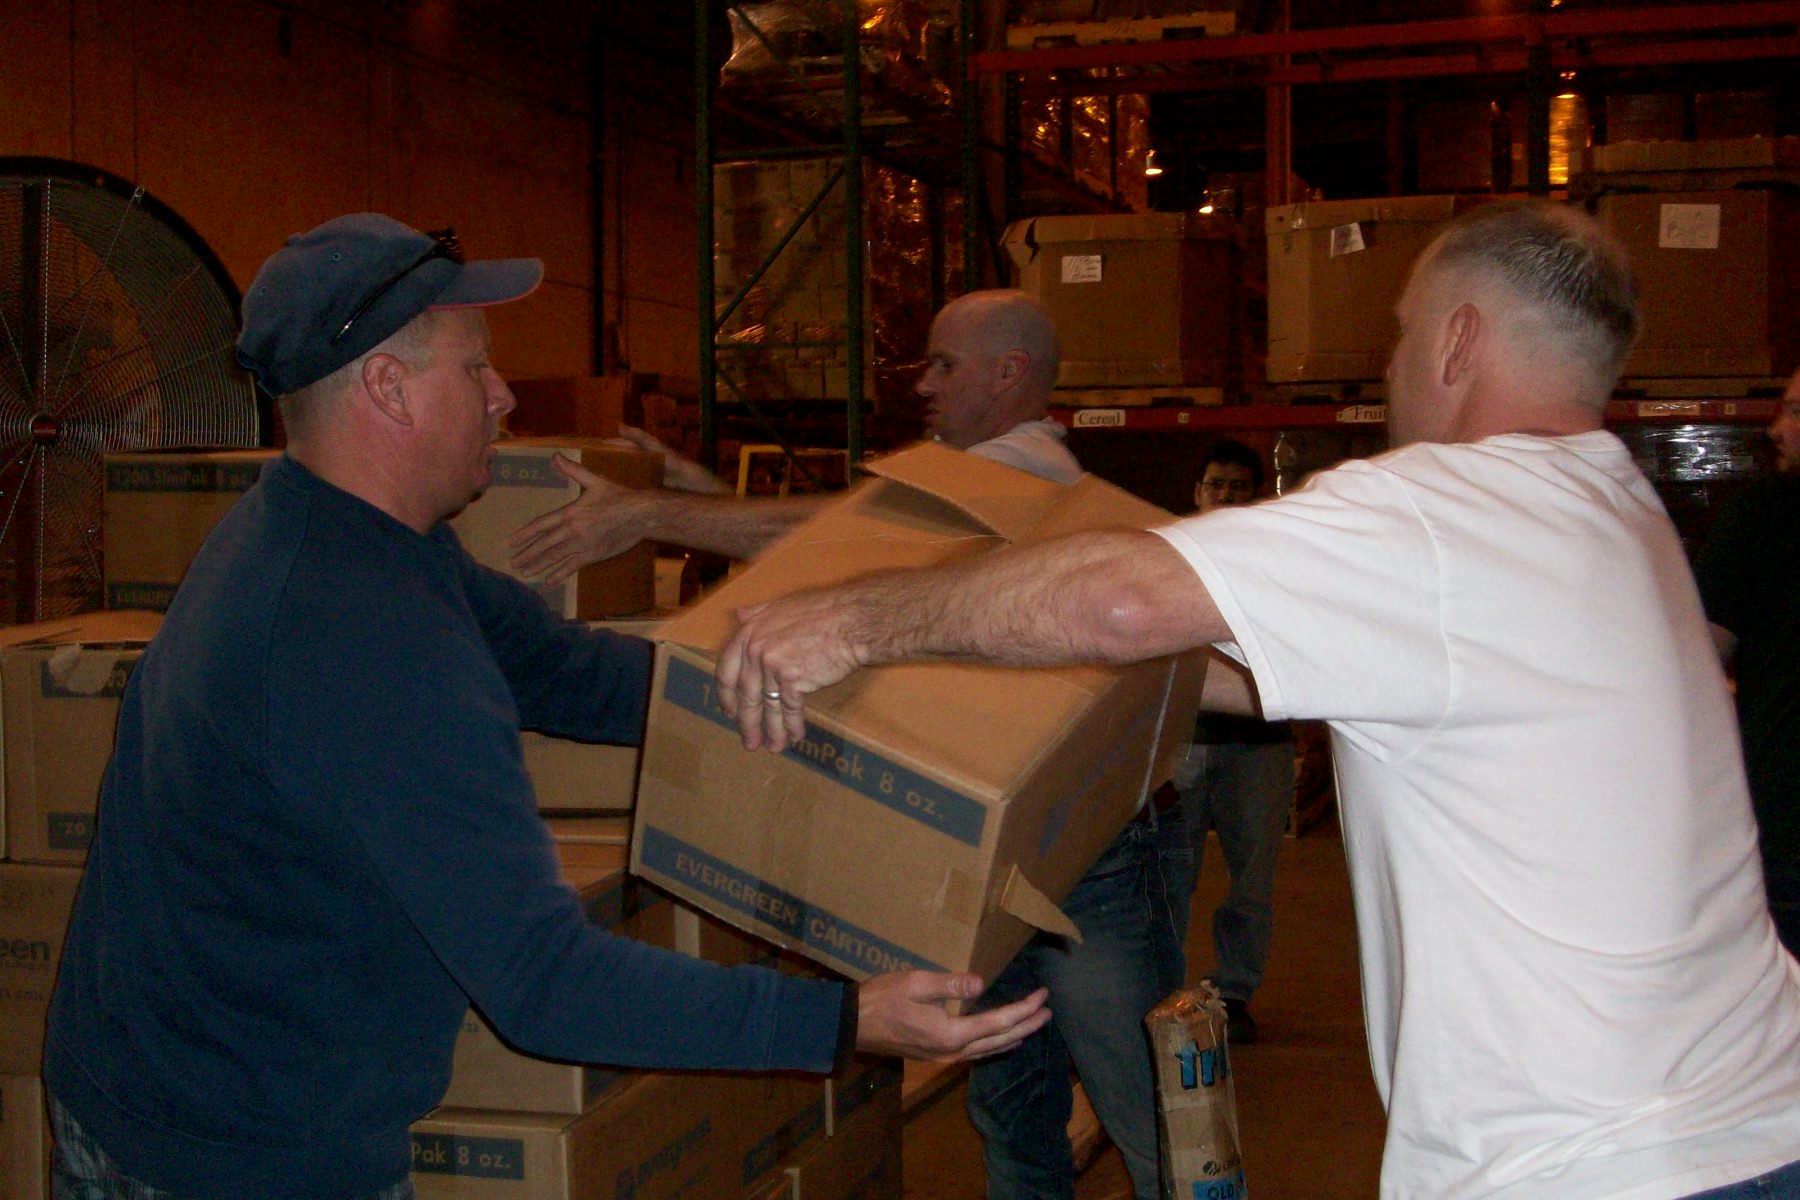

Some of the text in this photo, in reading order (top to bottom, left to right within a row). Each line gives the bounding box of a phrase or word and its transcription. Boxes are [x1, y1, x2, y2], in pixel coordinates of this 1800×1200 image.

[1079, 411, 1121, 426] Cereal
[500, 465, 511, 479] 8
[796, 738, 945, 822] mPak 8 oz.
[675, 852, 799, 925] EVERGREEN
[458, 1145, 470, 1166] 8
[479, 1153, 513, 1169] oz.
